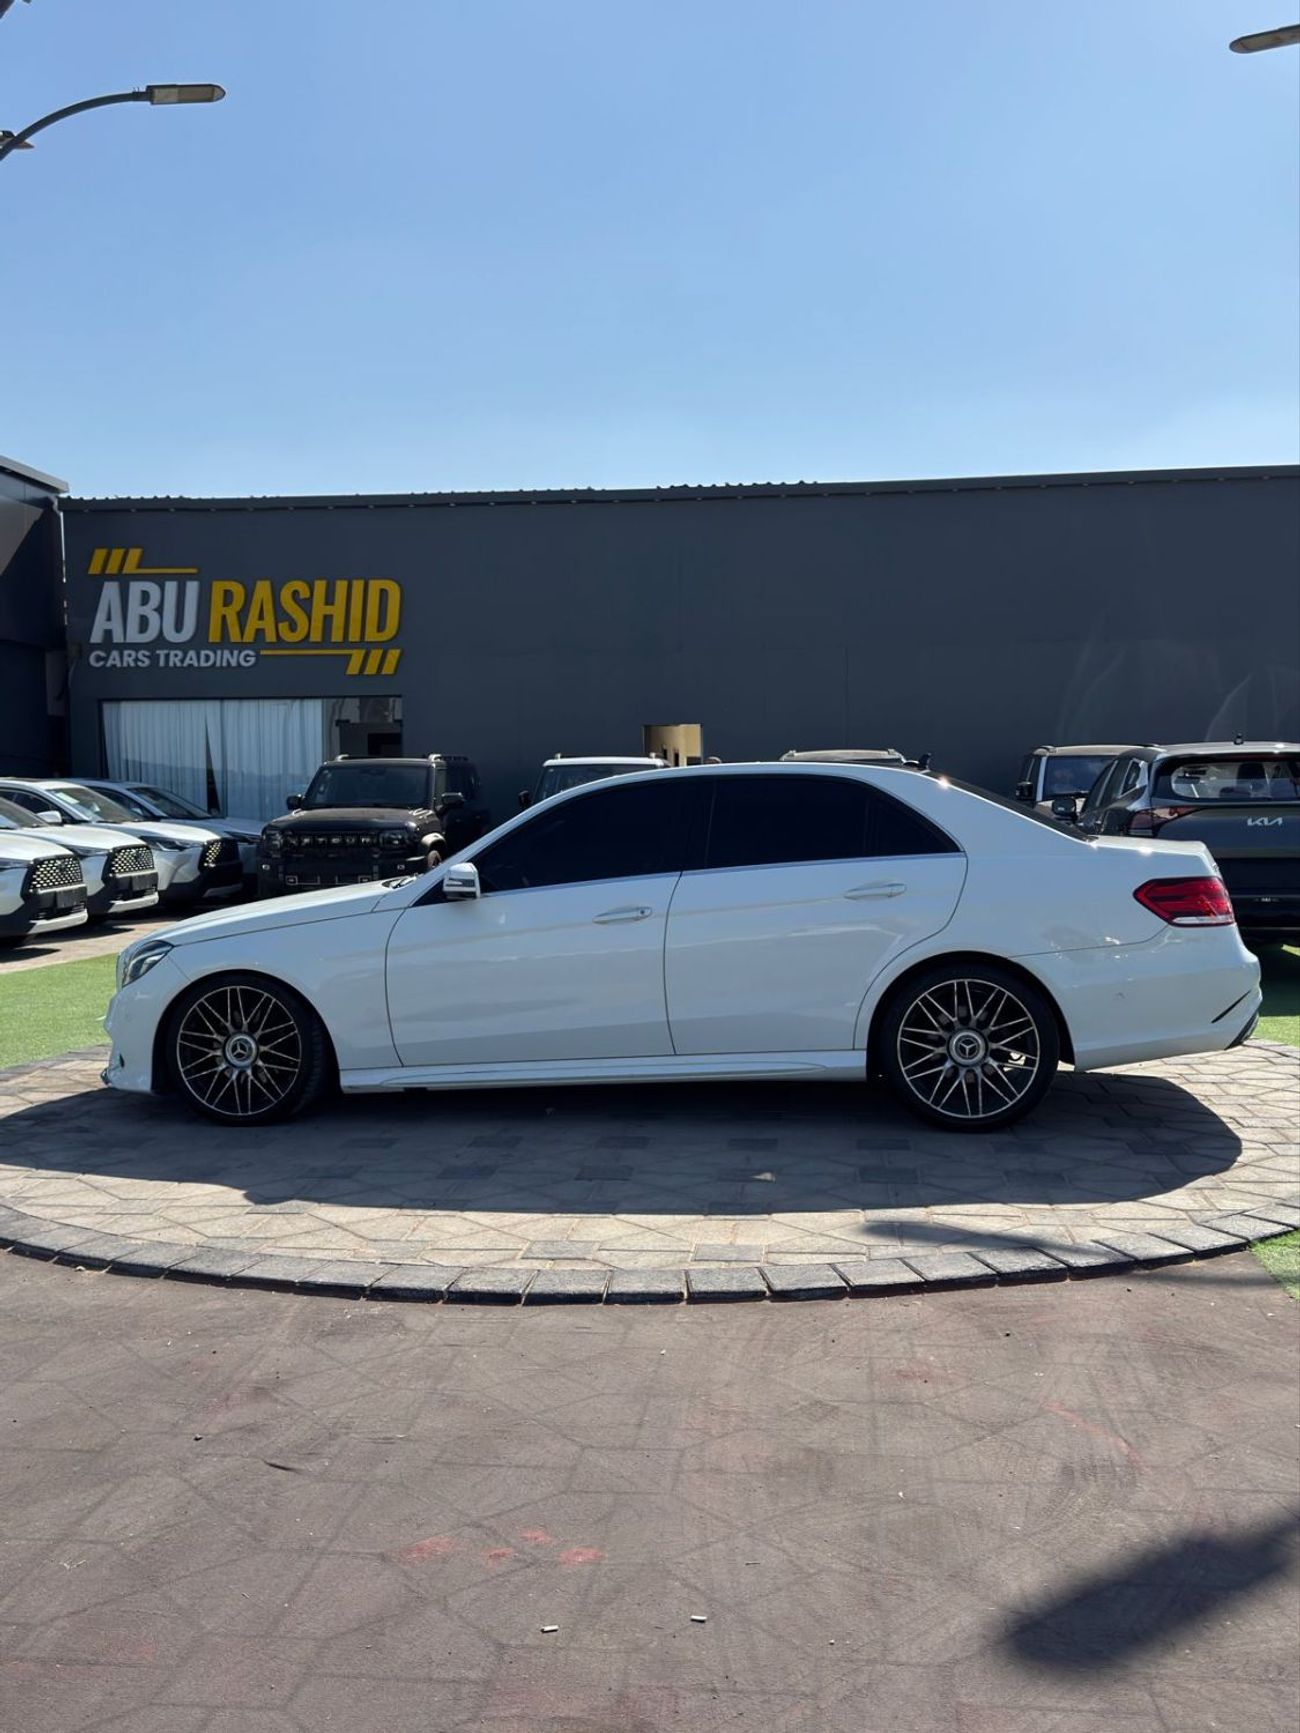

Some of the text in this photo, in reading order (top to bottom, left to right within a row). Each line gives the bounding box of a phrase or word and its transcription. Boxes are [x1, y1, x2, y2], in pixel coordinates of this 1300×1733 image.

[89, 579, 401, 643] ABU RASHID
[89, 649, 257, 668] CARS TRADING
[1247, 816, 1283, 826] KIA
